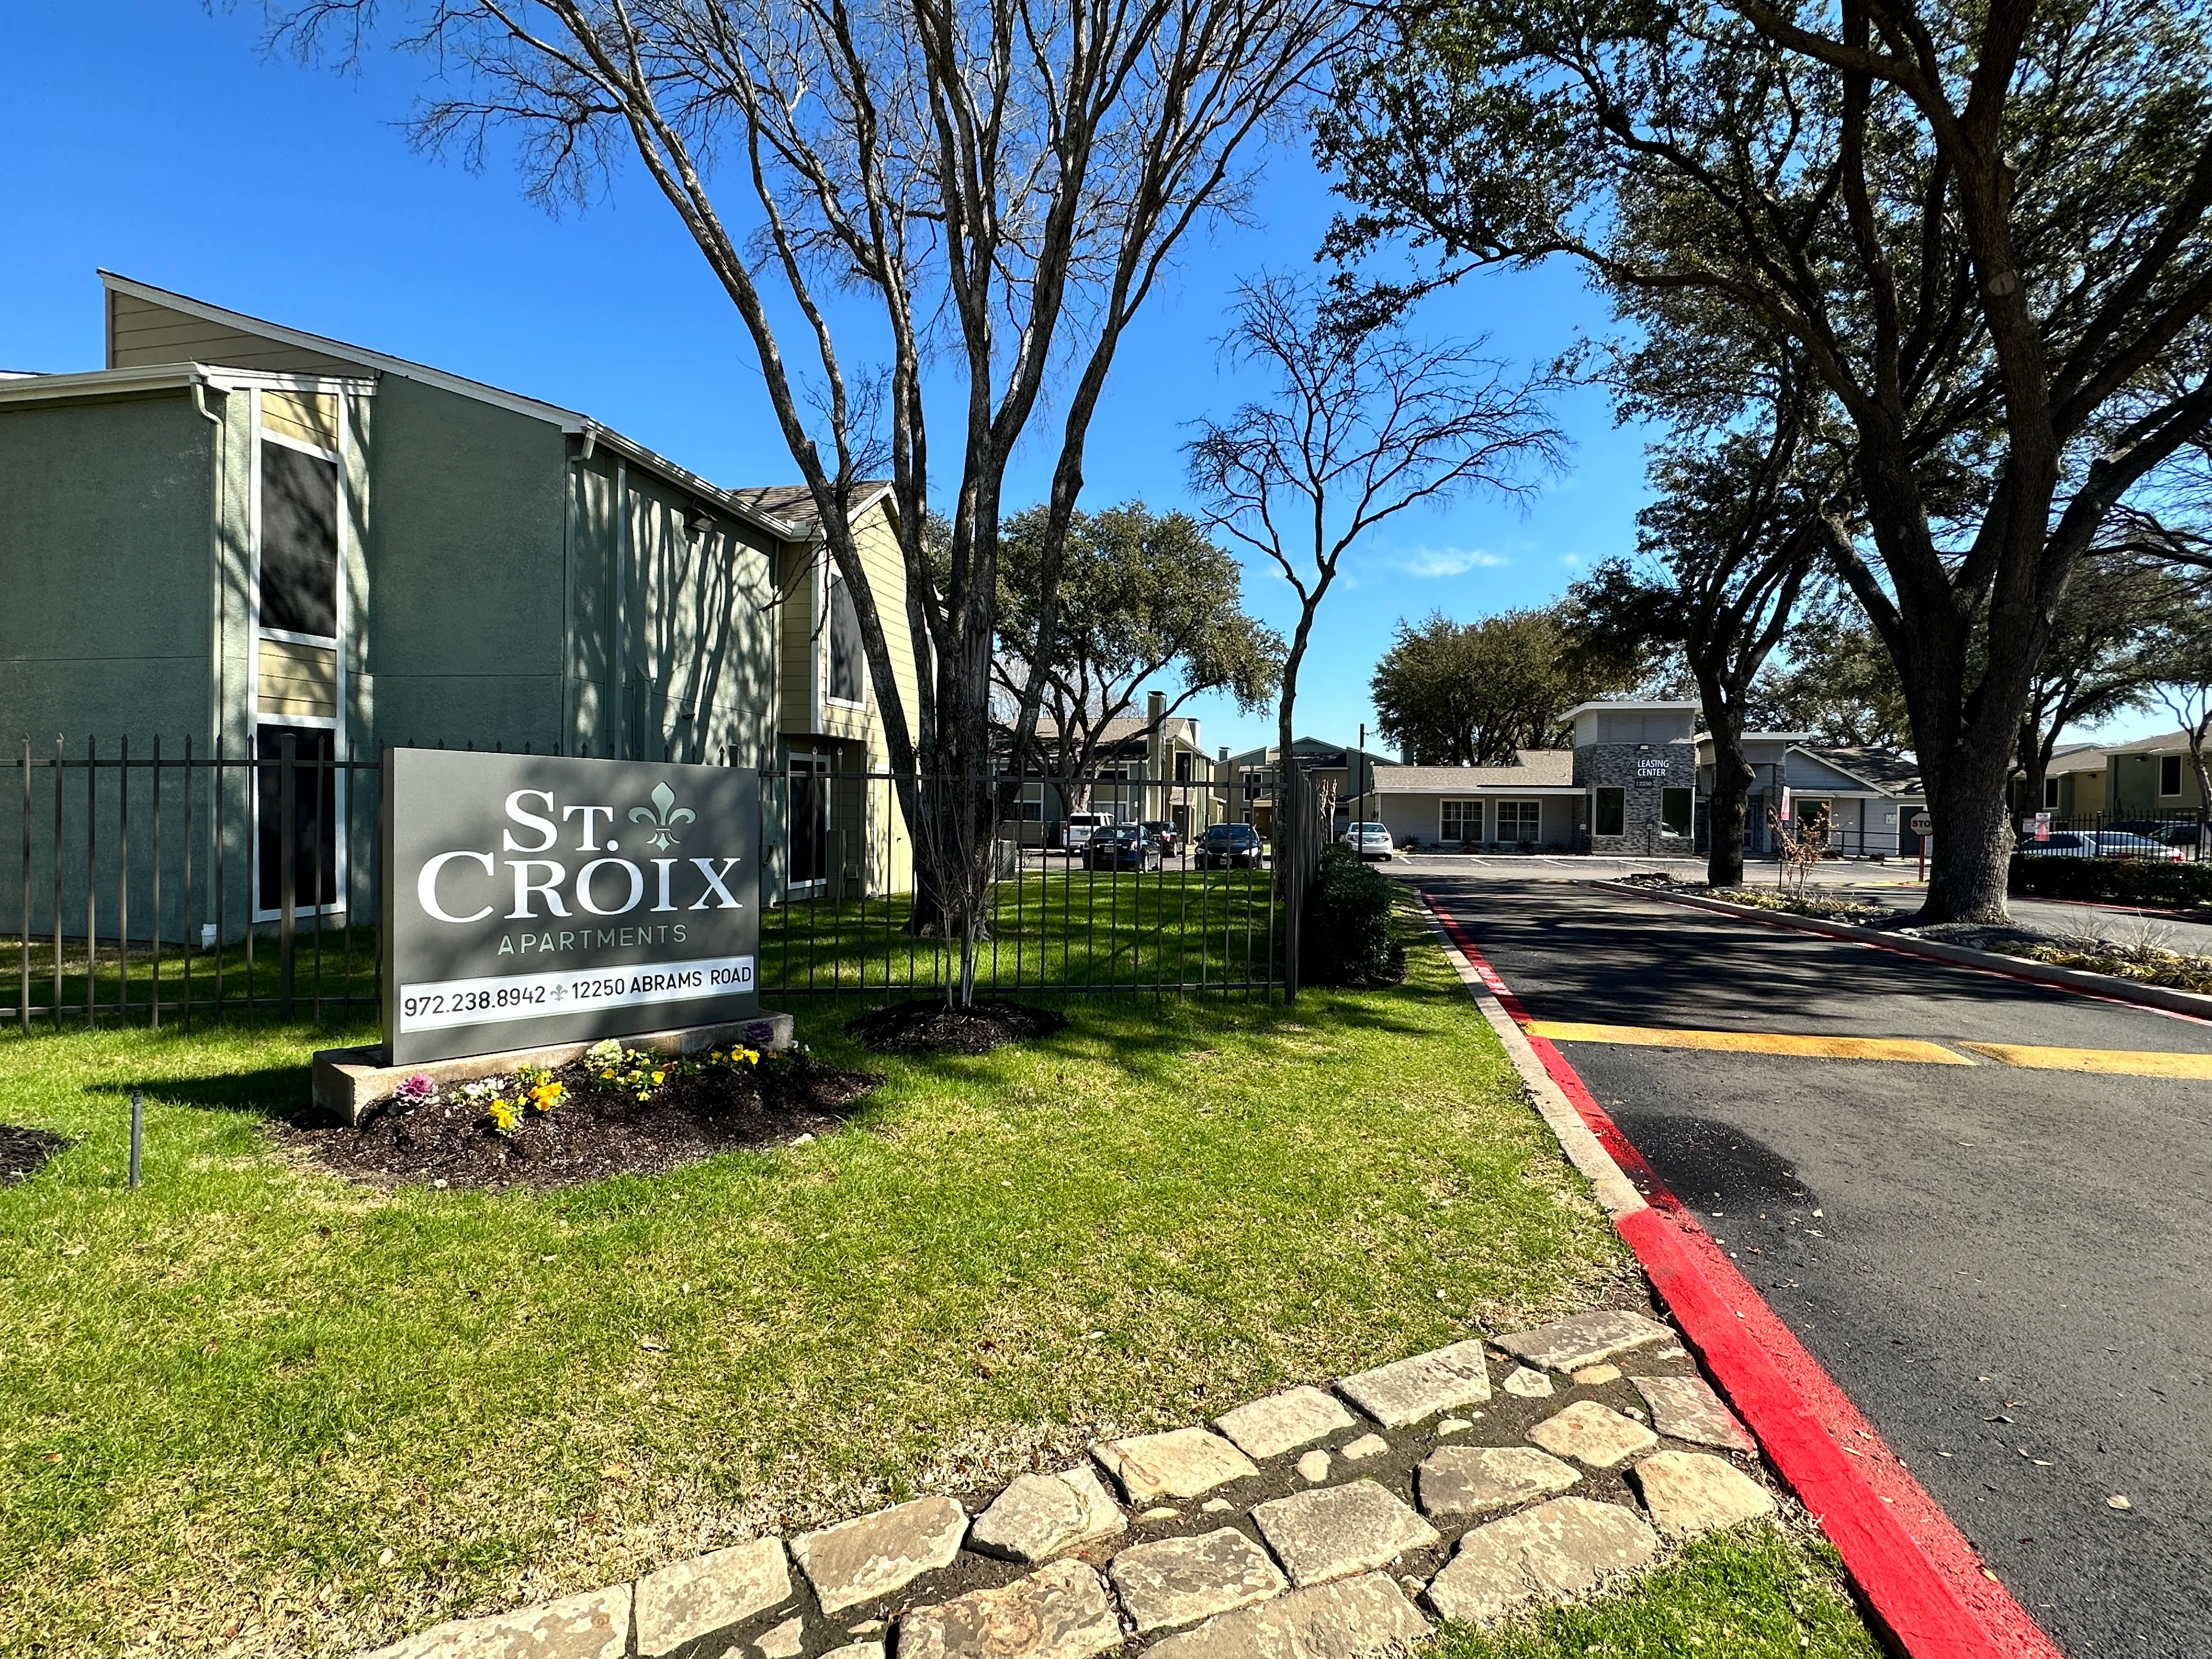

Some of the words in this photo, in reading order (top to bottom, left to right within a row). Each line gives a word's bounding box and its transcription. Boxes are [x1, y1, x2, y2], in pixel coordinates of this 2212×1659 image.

[1637, 759, 1669, 768] LEASING
[1637, 768, 1666, 776] CENTER
[503, 789, 619, 853] ST.
[417, 850, 744, 924] CROIX
[497, 924, 688, 956] APARTMENTS
[404, 986, 546, 1017] 972.238.8942
[572, 978, 625, 1000] 12250
[630, 970, 702, 994] ABRAMS
[710, 966, 752, 985] ROAD
